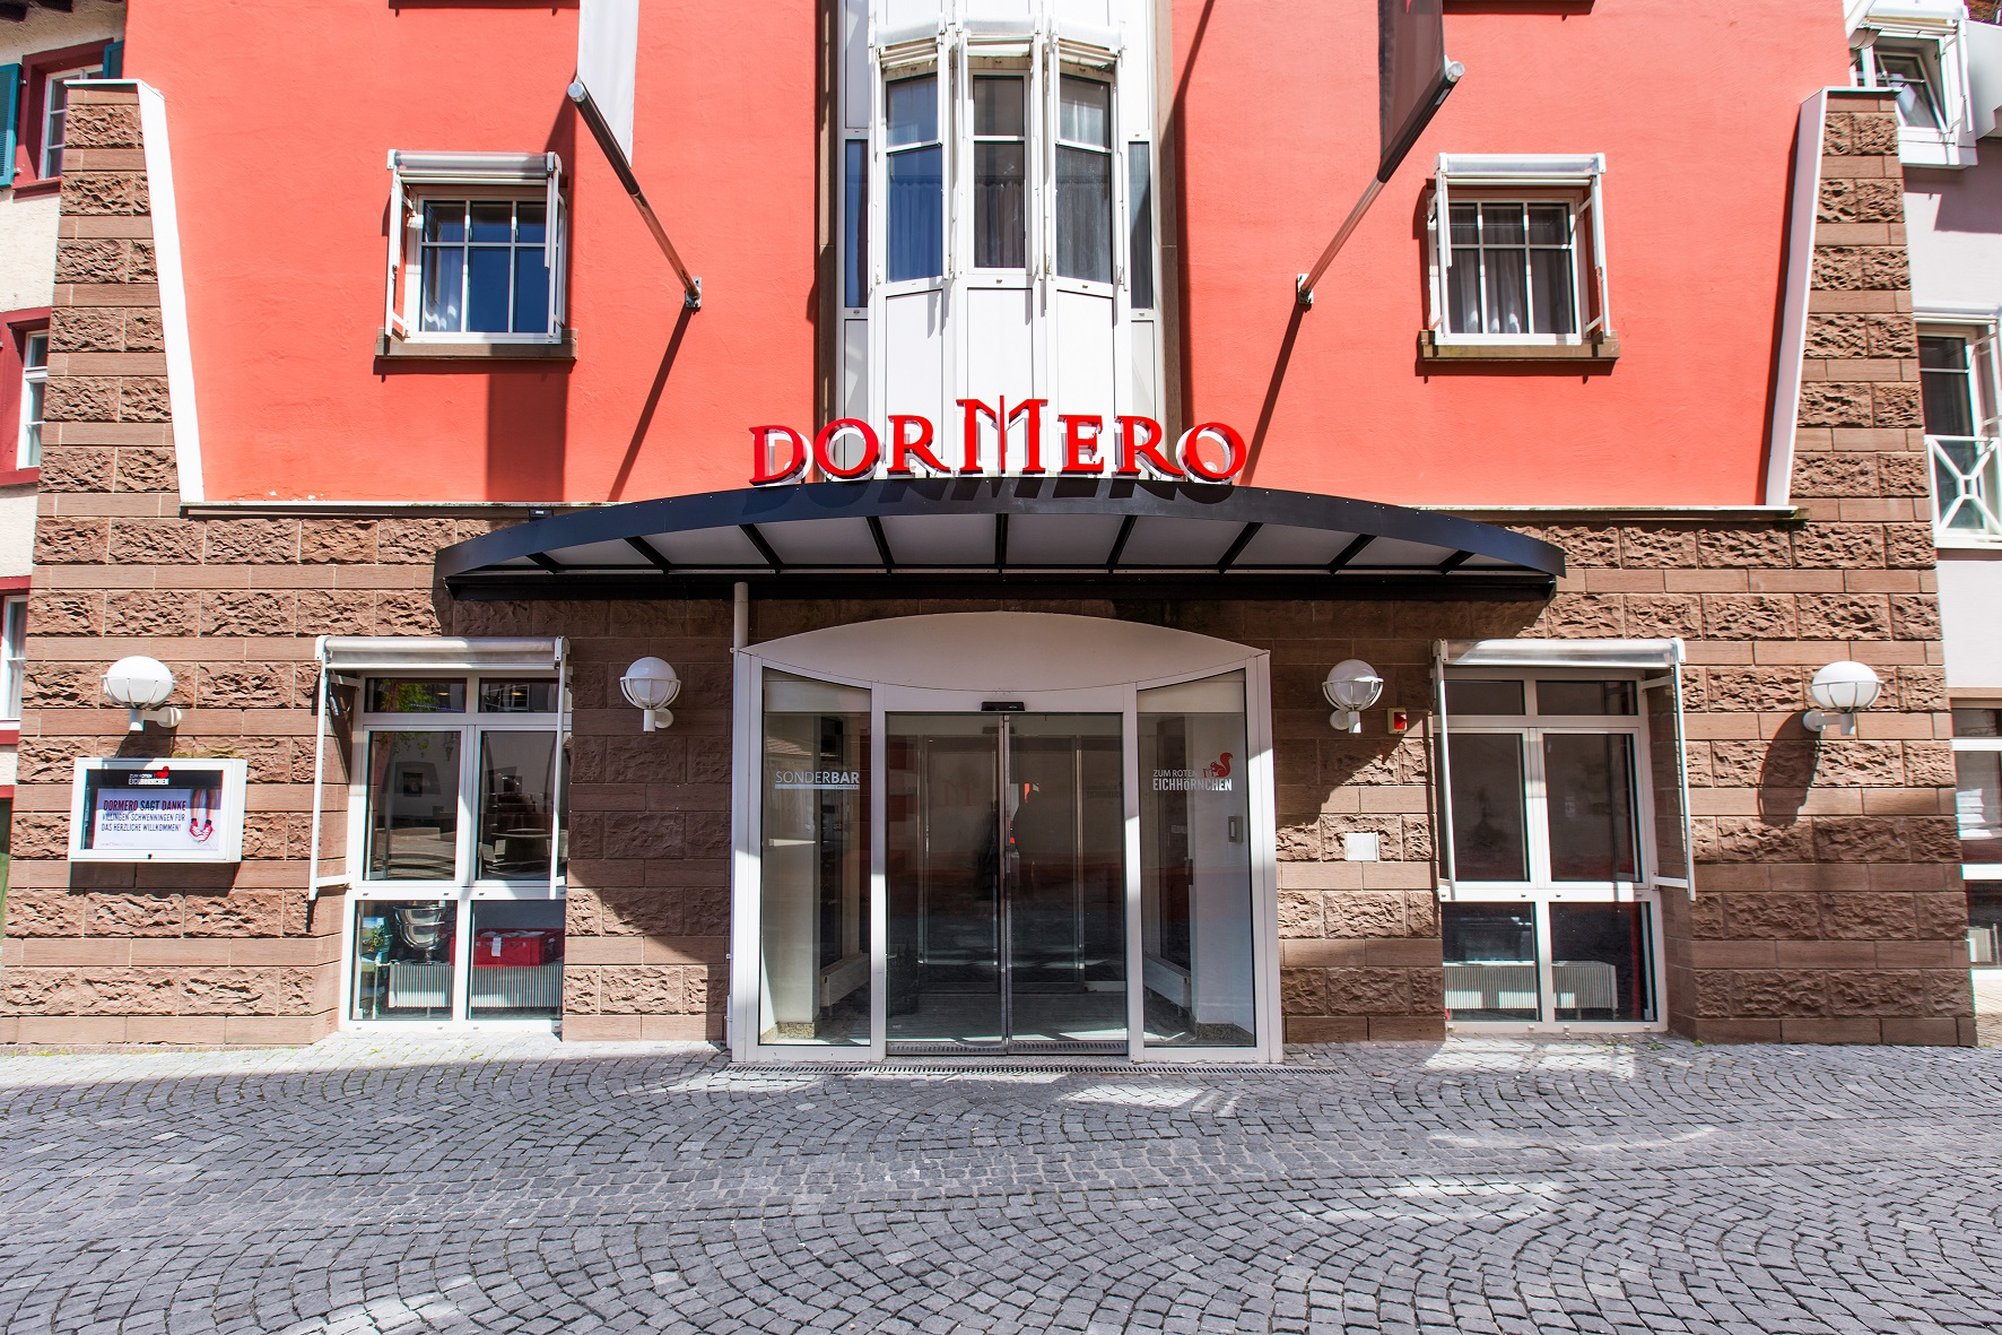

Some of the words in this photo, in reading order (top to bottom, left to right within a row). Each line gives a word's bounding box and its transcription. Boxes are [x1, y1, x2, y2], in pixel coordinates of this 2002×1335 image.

[749, 395, 1248, 485] DORMERO
[775, 770, 860, 784] SONDERBAR
[1153, 769, 1171, 777] ZUM
[103, 799, 138, 811] DORMERO
[140, 799, 160, 811] SAGT
[162, 800, 187, 811] DANKE
[101, 823, 112, 832] DAS
[113, 823, 141, 832] HERZLICHE
